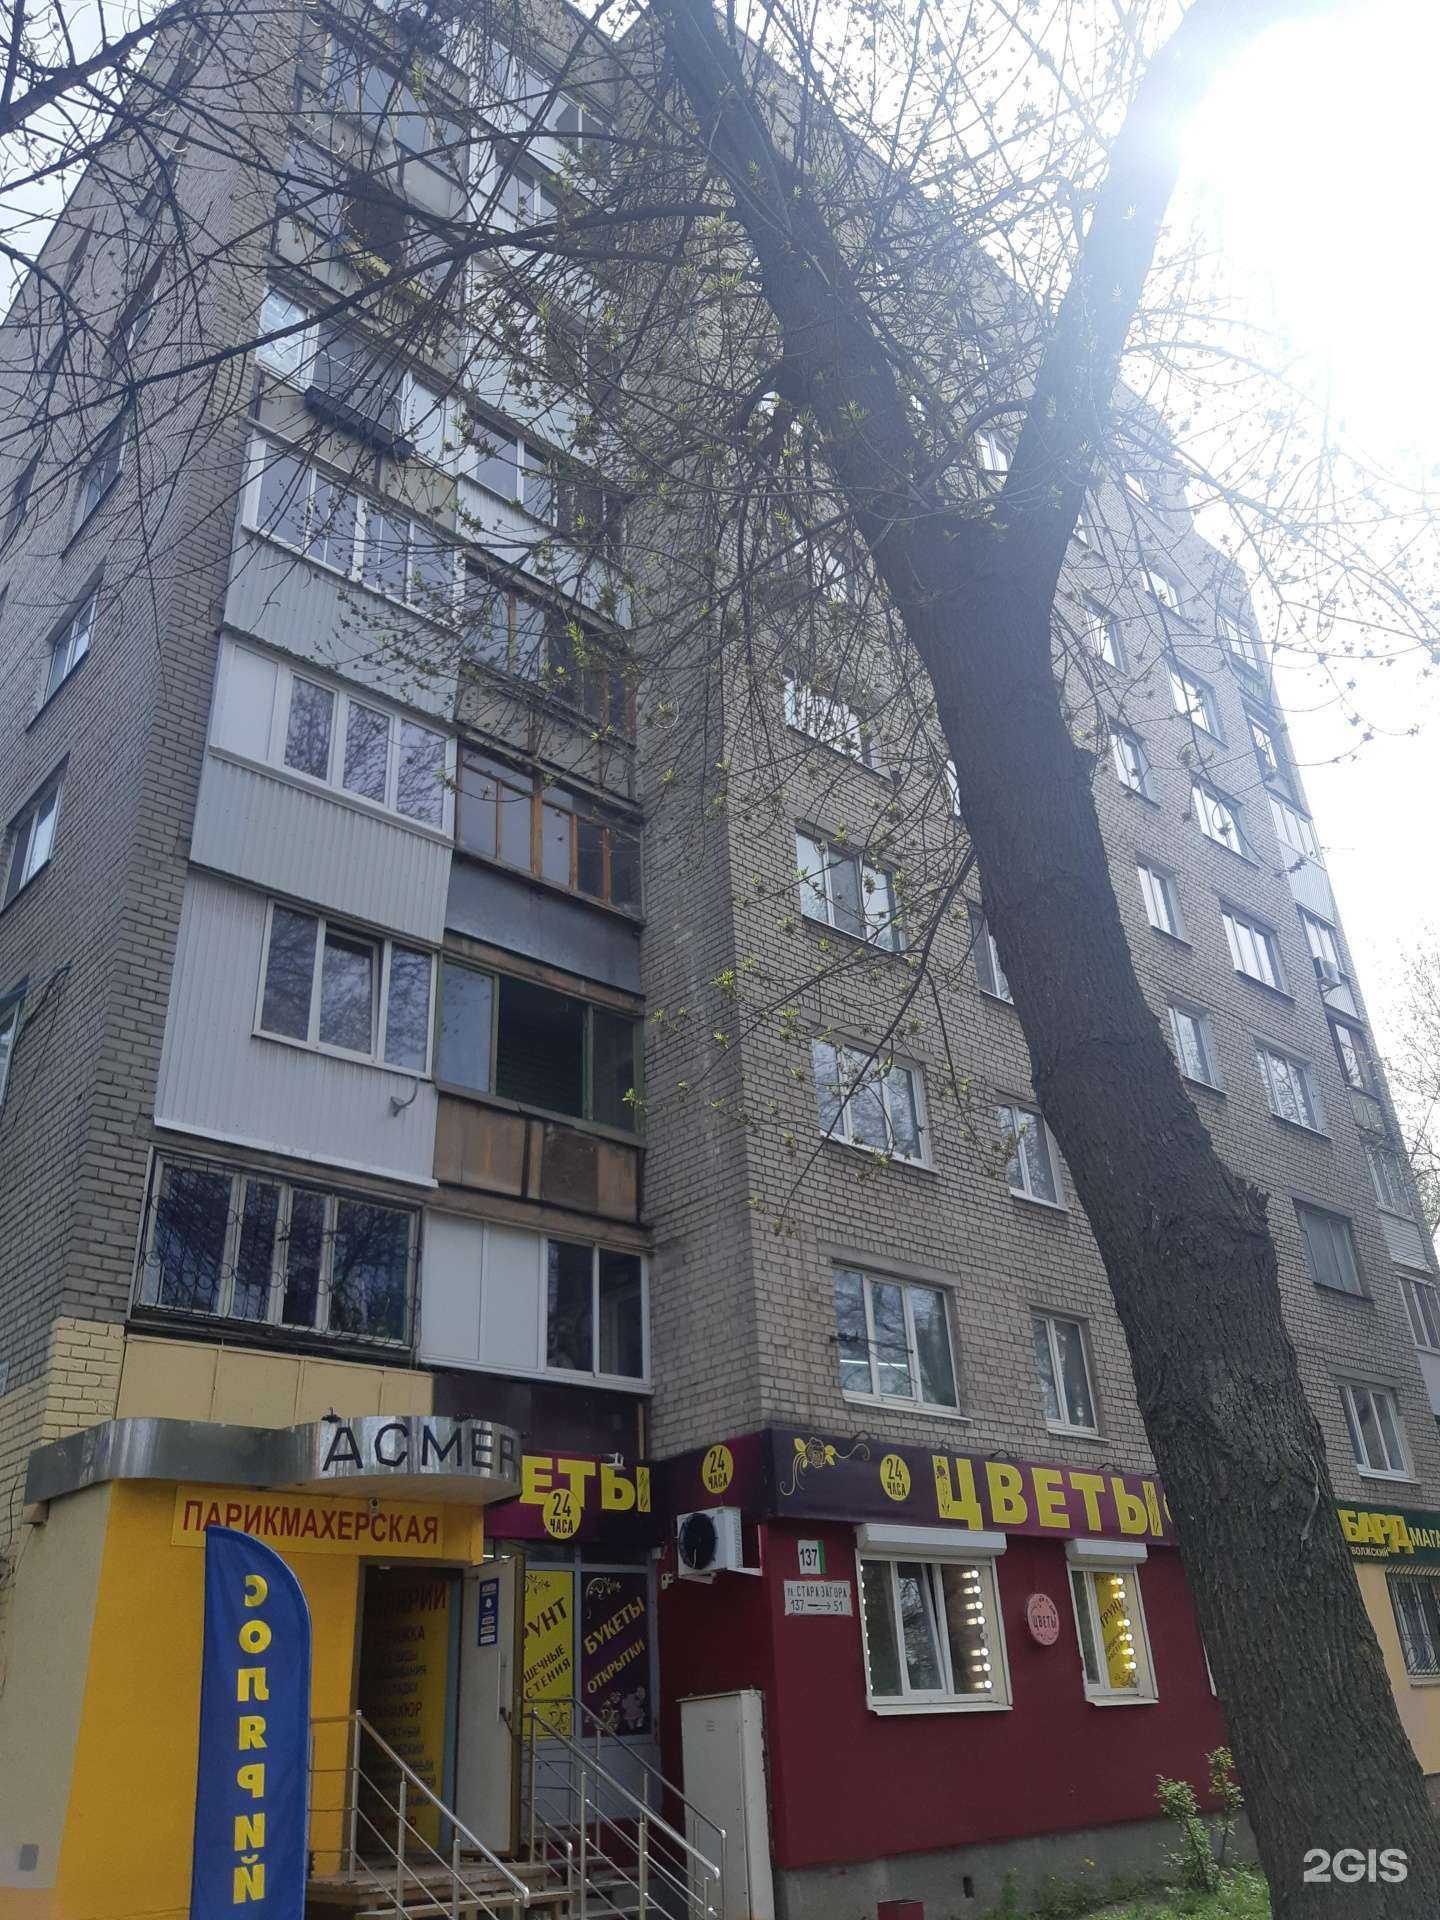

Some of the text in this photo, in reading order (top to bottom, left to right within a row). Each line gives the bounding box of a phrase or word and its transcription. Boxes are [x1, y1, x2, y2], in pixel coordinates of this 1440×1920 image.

[708, 1448, 725, 1473] 24
[886, 1457, 903, 1481] 24
[518, 1454, 651, 1513] ЕТЫ
[708, 1474, 728, 1489] ЧАСА
[886, 1480, 908, 1498] ЧАСА
[552, 1491, 572, 1517] 24
[931, 1454, 1164, 1537] ЦВЕТЫ
[182, 1500, 439, 1545] ПАРИКМАХЕРСКАЯ
[550, 1519, 574, 1534] ЧАСА
[1337, 1509, 1415, 1554] БАРД
[800, 1548, 818, 1566] 137
[796, 1585, 820, 1598] СТАРА
[791, 1599, 844, 1612] 137 51
[584, 1596, 647, 1656] БУКЕТЫ
[1031, 1615, 1057, 1631] ЦВЕТЫ
[523, 1643, 567, 1684] ШЕЧНЫЕ
[586, 1638, 647, 1695] ОТКРЫТКИ
[525, 1657, 572, 1700] СТЕНИЯ
